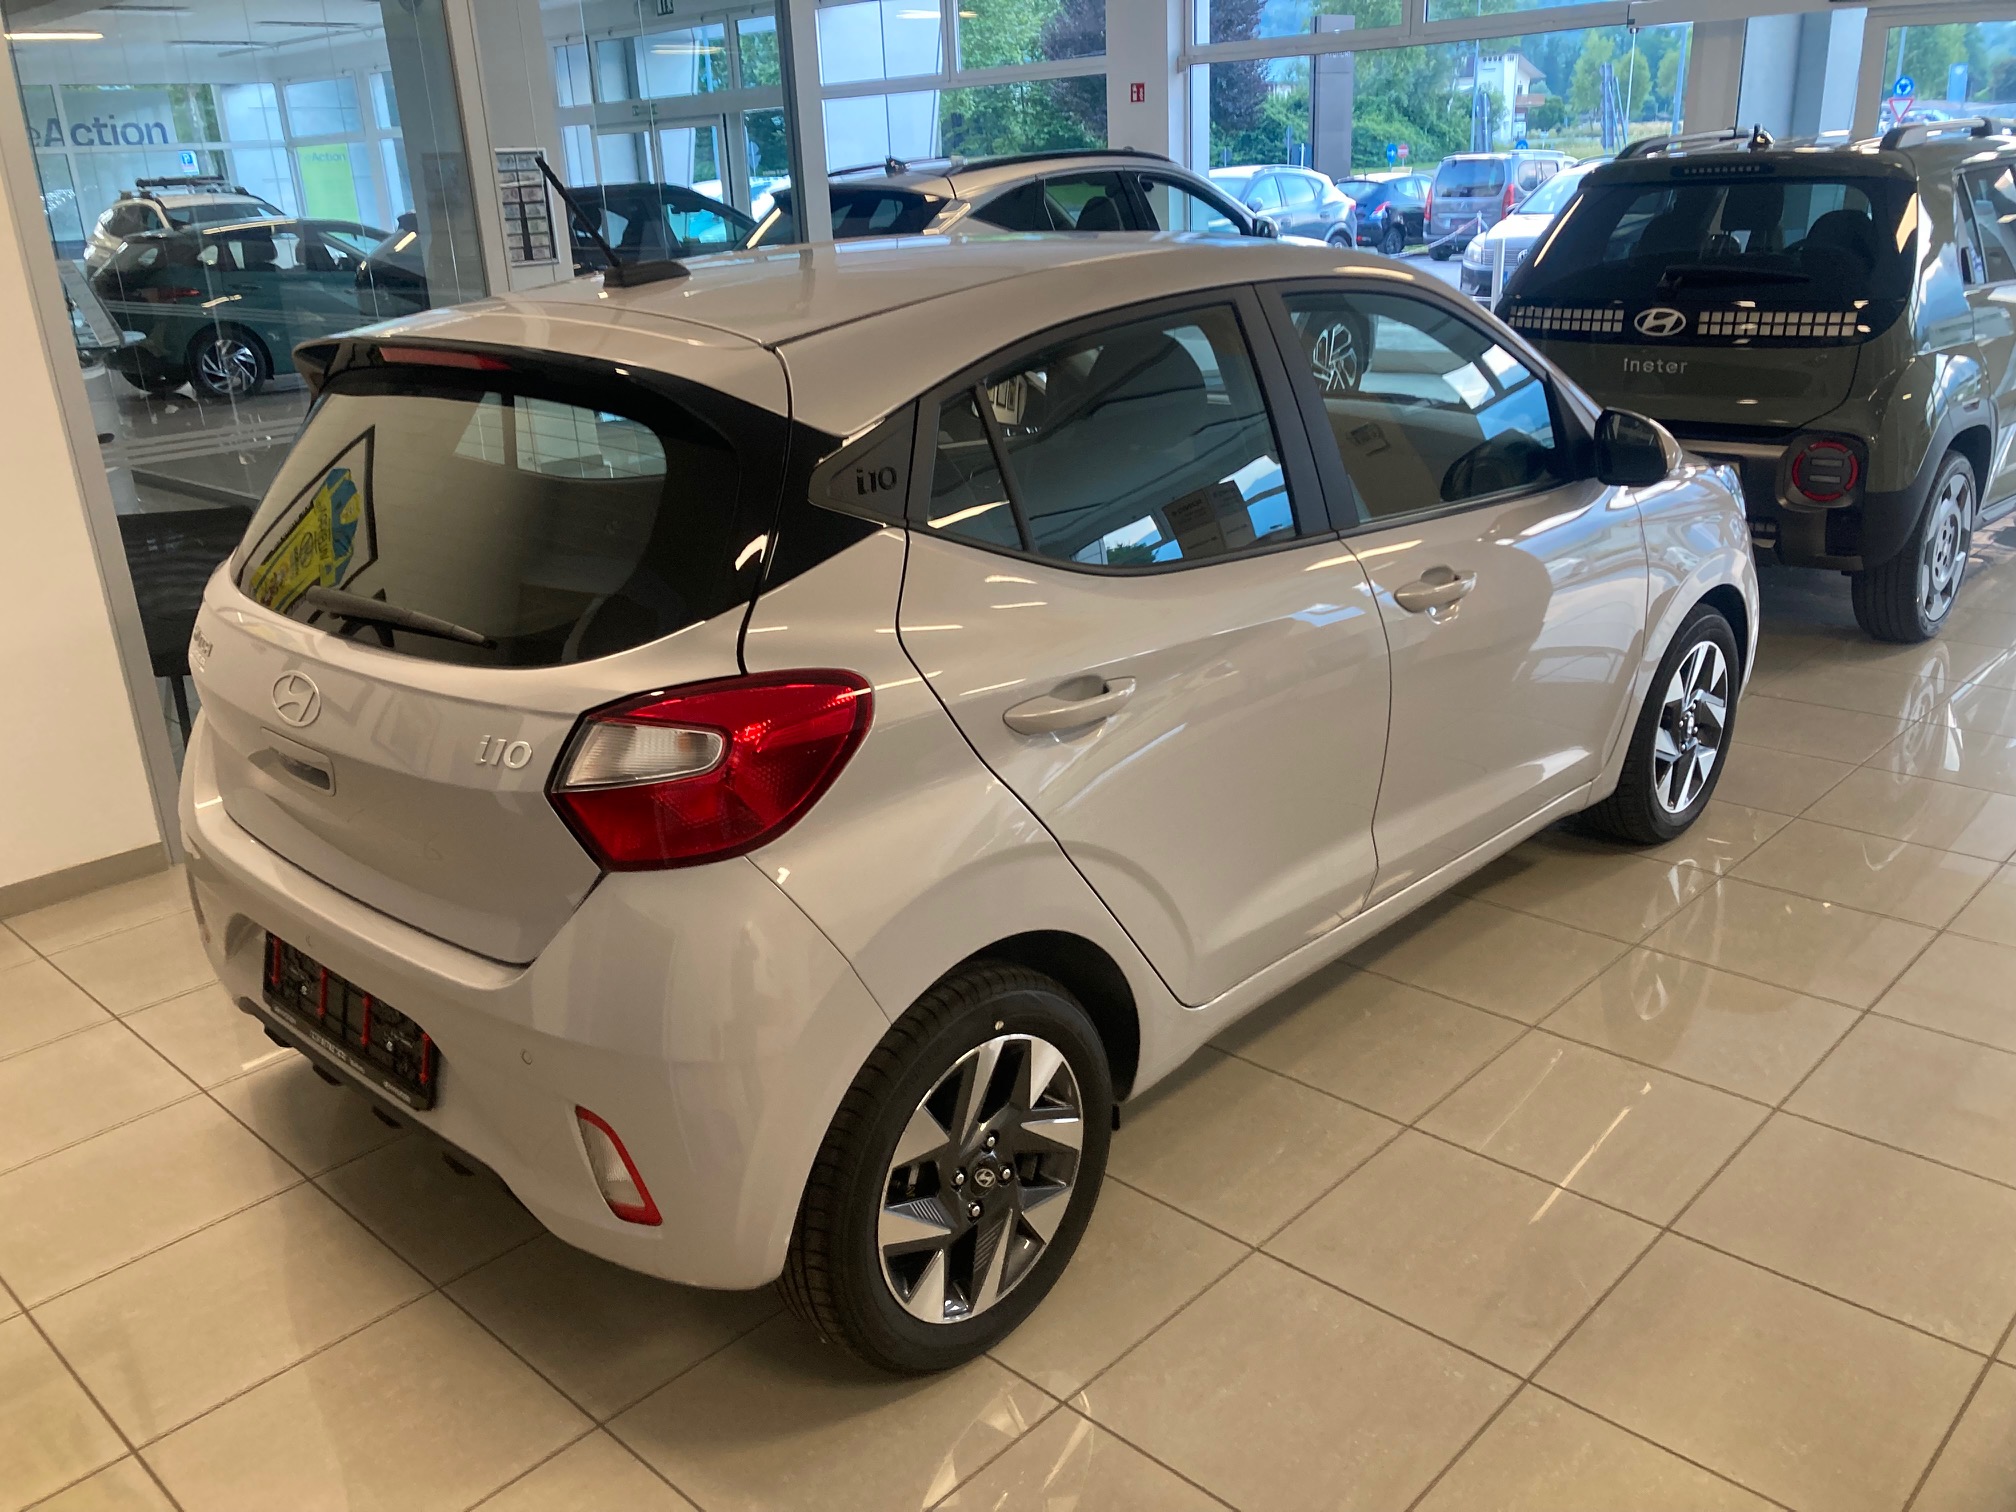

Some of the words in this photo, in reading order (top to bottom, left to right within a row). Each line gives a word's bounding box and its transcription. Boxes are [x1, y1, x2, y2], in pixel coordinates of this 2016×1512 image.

[27, 115, 169, 147] eAction
[856, 466, 898, 495] i10
[474, 734, 533, 769] i10
